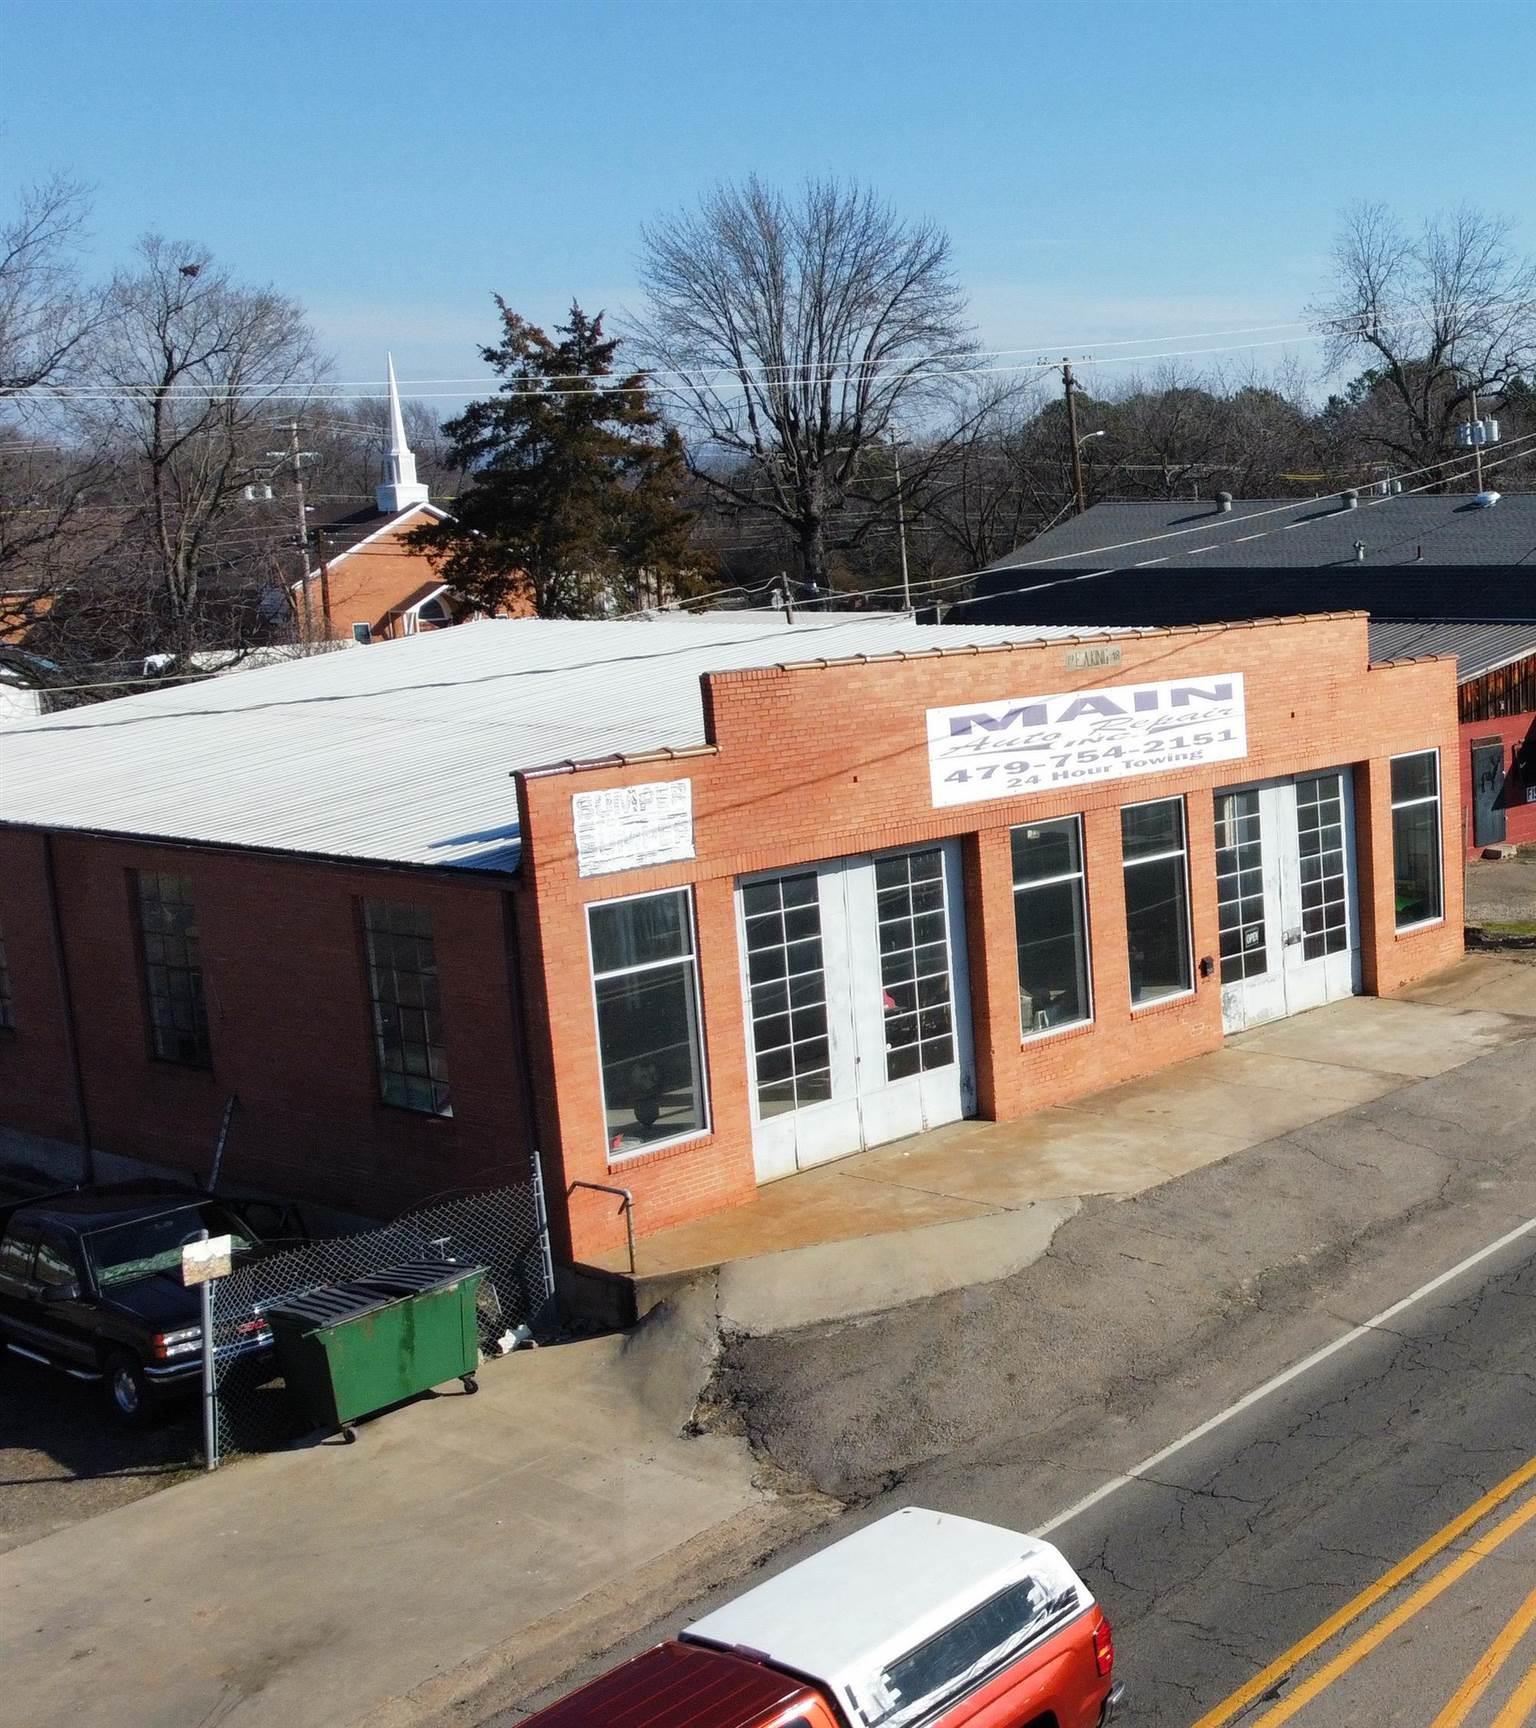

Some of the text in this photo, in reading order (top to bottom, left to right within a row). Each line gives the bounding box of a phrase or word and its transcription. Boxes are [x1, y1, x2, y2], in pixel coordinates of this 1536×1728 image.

[942, 707, 1234, 757] Auto Repair
[949, 683, 1233, 737] MAIN
[944, 728, 1238, 785] 479-754-2151
[1007, 748, 1205, 789] 24 Hour Towing
